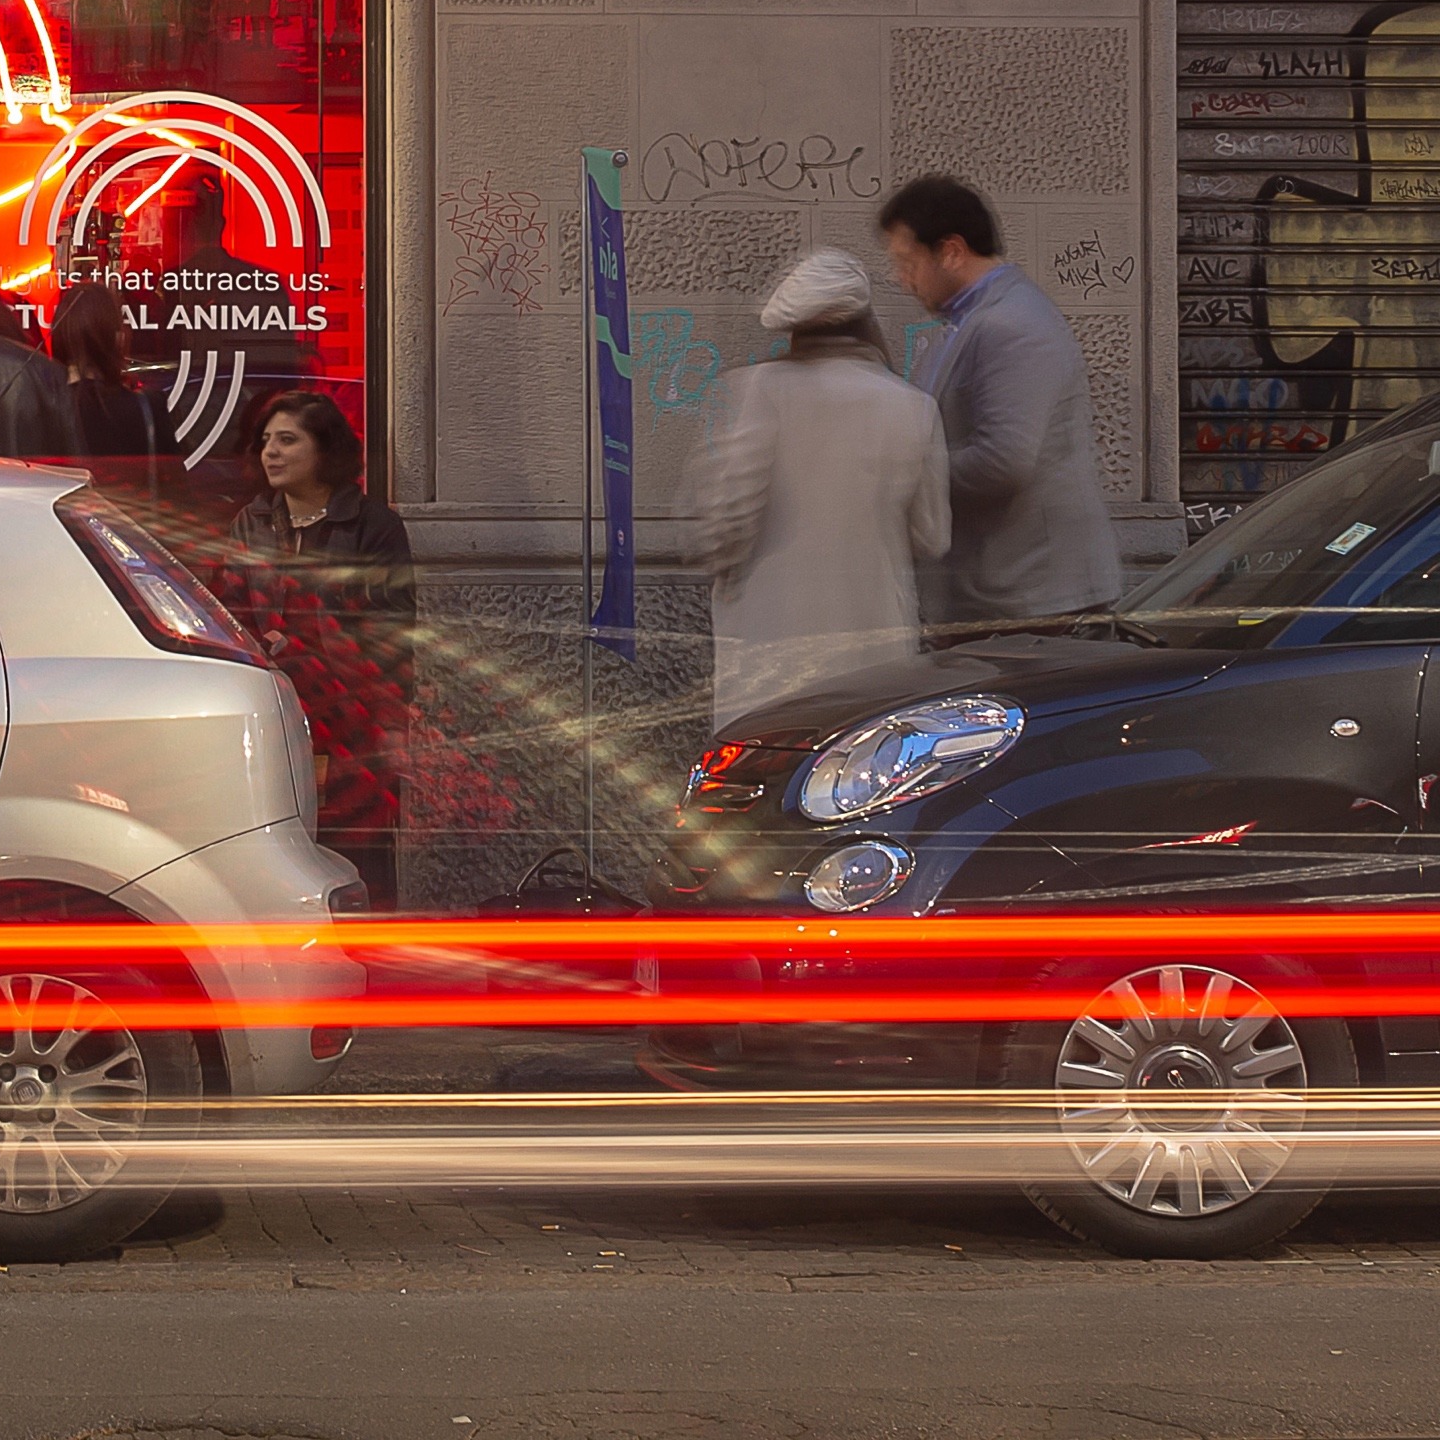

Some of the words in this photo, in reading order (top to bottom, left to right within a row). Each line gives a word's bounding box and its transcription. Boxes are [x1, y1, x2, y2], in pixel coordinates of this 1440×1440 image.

[1257, 51, 1342, 77] SLASH
[90, 265, 155, 291] that
[163, 268, 280, 292] attracts
[289, 270, 330, 292] us:
[166, 304, 328, 331] ANIMALS
